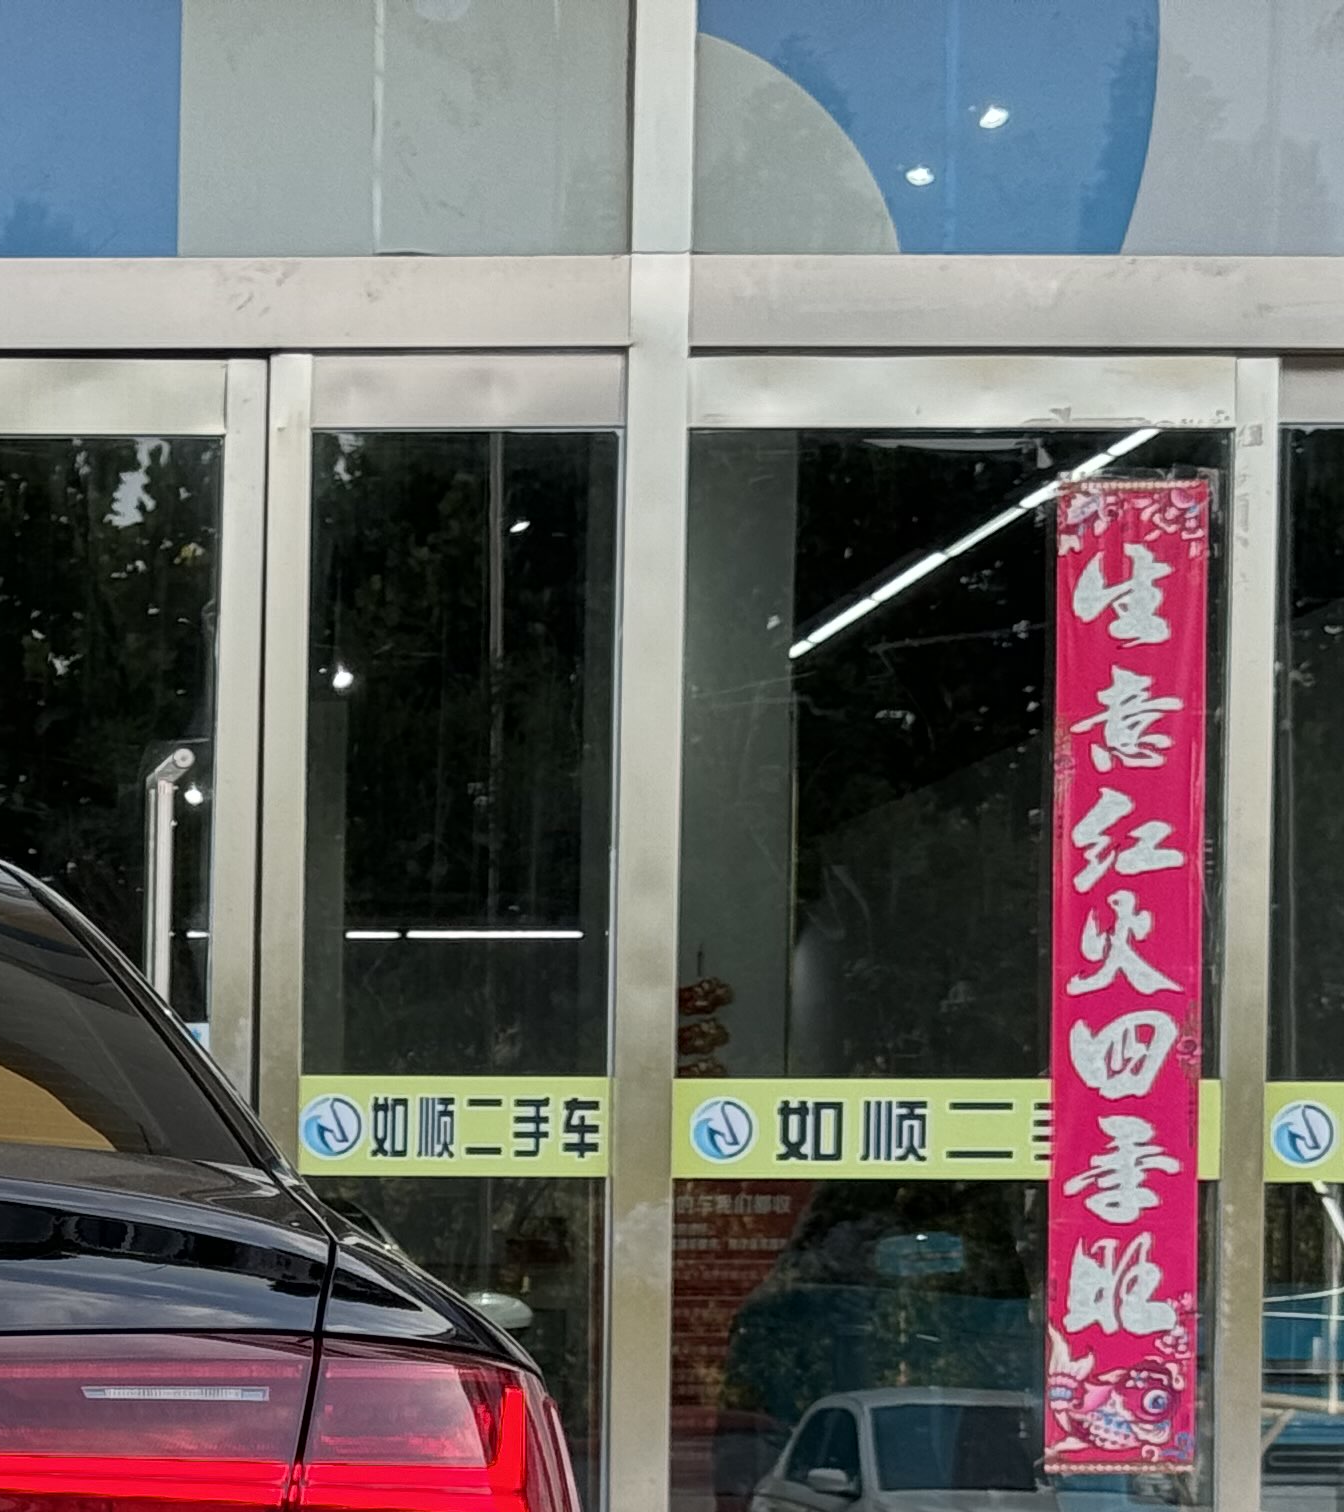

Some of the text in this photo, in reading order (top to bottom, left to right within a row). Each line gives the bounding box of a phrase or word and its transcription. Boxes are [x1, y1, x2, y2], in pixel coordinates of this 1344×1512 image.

[370, 1096, 601, 1161] 如顺二手车
[1062, 543, 1185, 1336] 生意红火四季旺
